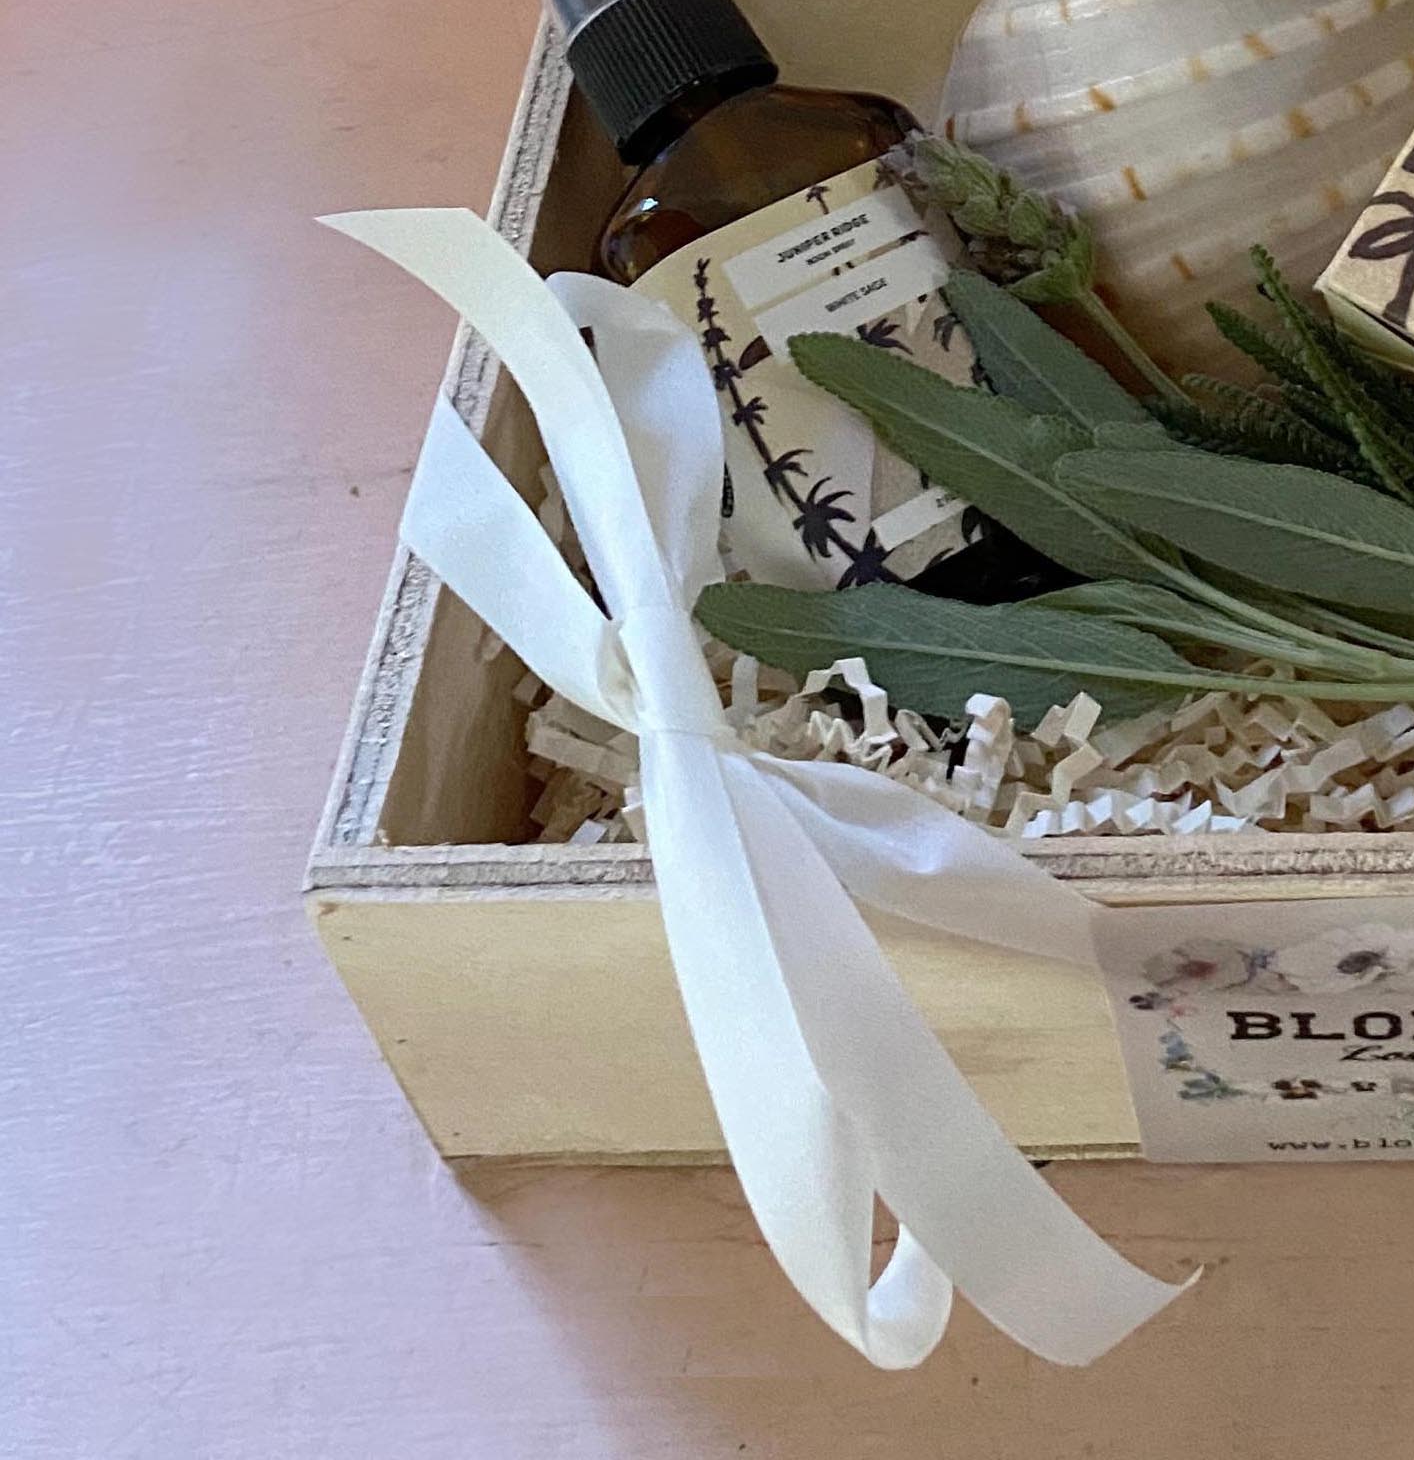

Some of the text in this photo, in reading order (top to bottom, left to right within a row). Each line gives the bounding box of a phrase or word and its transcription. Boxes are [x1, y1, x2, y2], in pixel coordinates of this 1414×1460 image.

[777, 231, 831, 263] JUNIPER
[830, 213, 870, 236] RIDGE
[859, 277, 888, 296] SAGE
